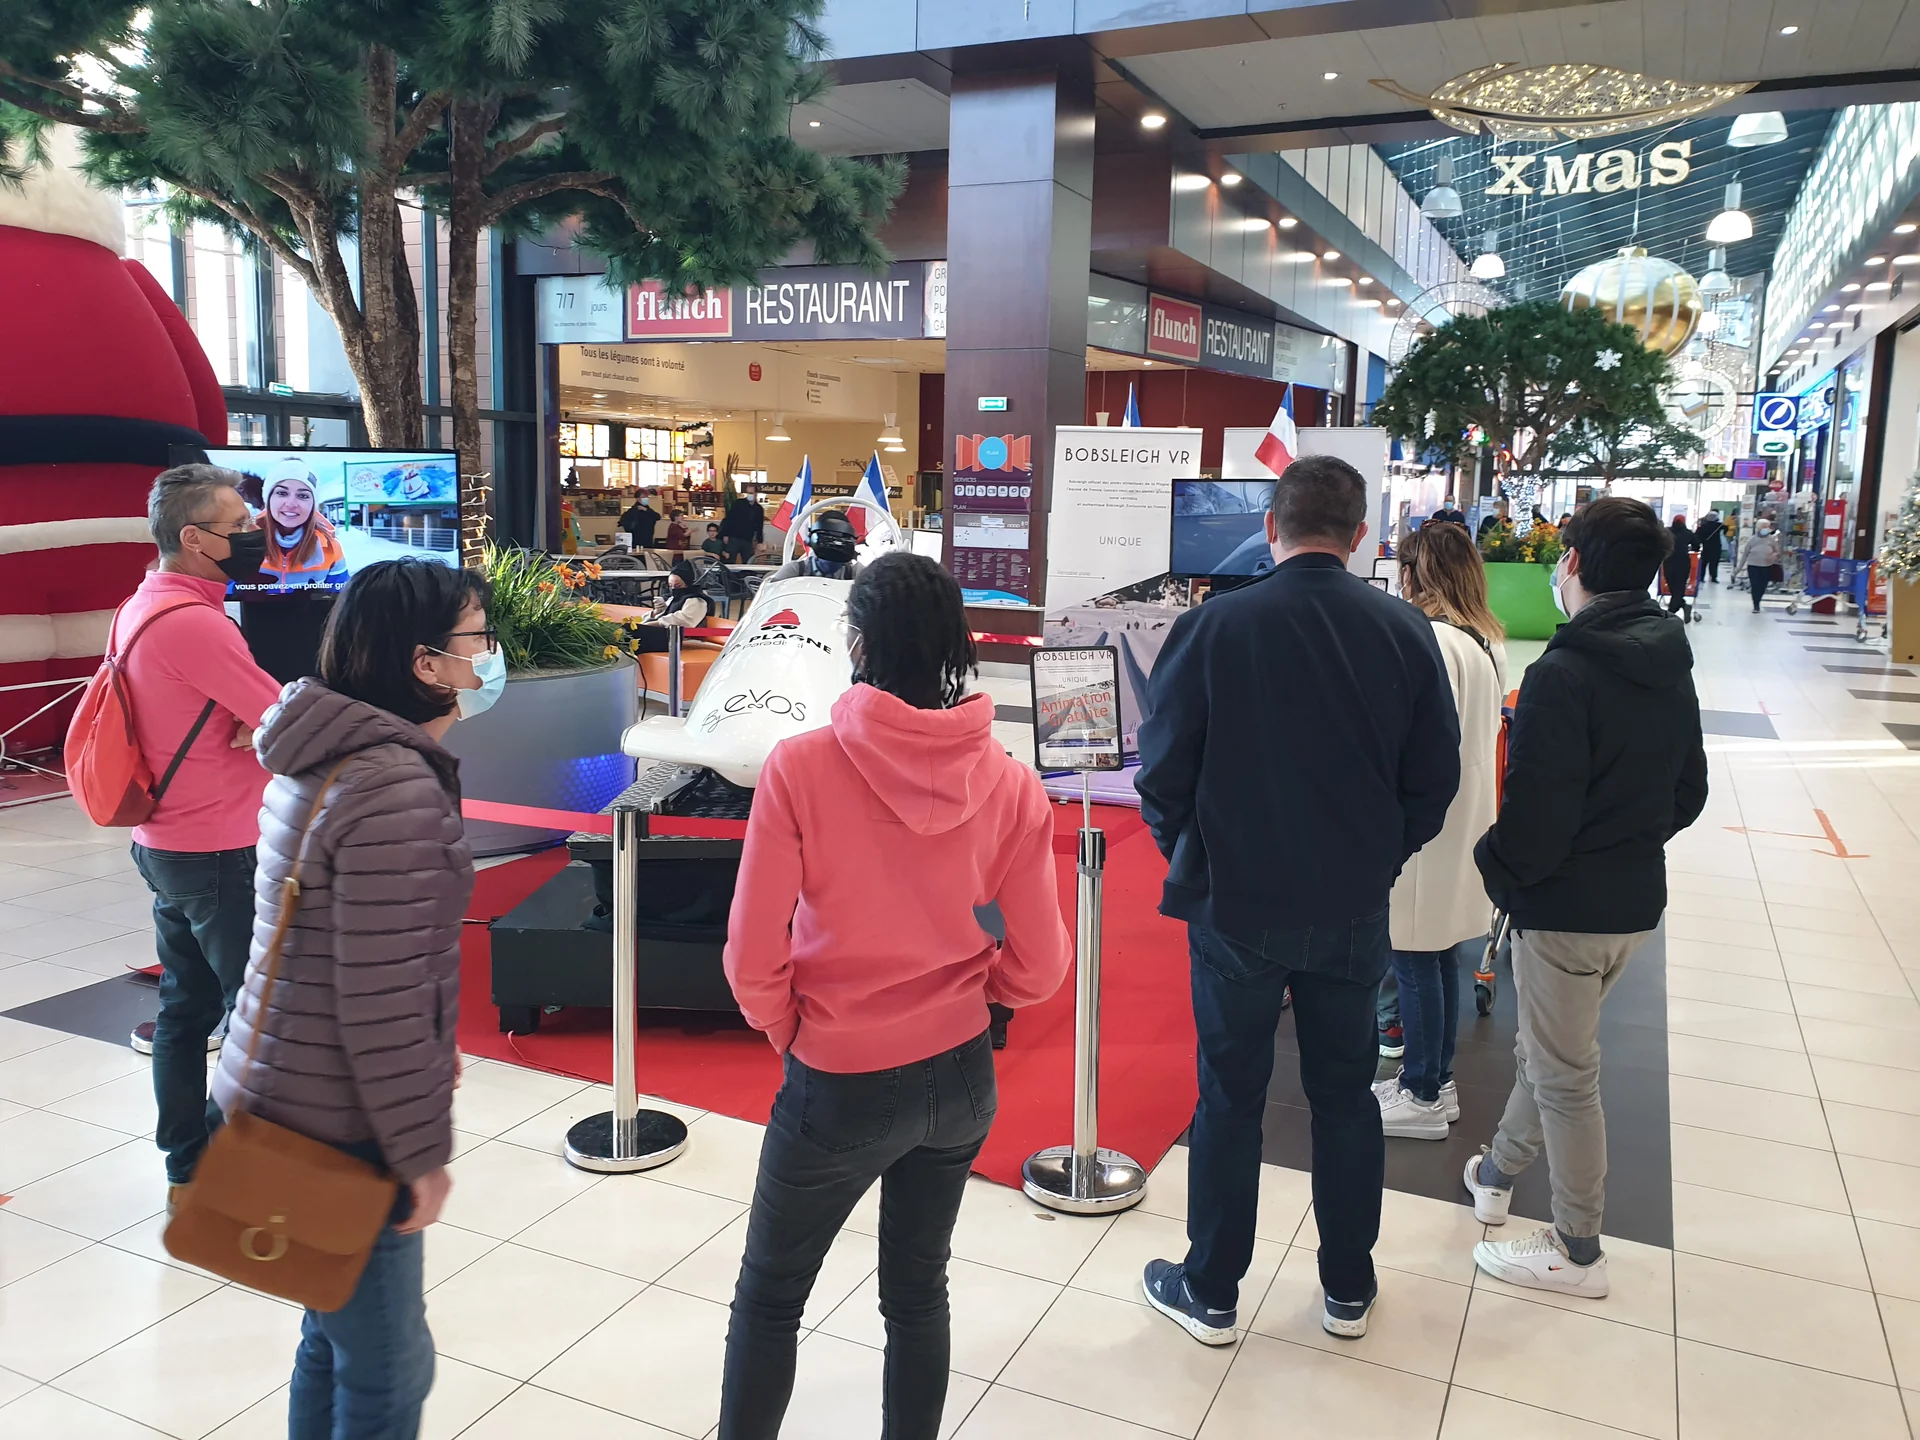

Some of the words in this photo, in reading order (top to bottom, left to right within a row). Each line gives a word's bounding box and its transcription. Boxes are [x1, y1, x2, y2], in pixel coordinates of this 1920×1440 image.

[556, 293, 574, 309] 7/7
[590, 302, 607, 314] jours
[636, 290, 722, 321] flunch
[746, 280, 910, 325] RESTAURANT
[1153, 307, 1197, 345] flunch
[1206, 318, 1270, 365] RESTAURANT
[580, 345, 597, 358] Tous
[598, 348, 609, 360] les
[610, 349, 639, 364] légumes
[640, 356, 655, 366] sont
[656, 357, 660, 368] à
[661, 358, 685, 371] volonté
[1065, 448, 1160, 464] BOBSLEIGH
[1168, 450, 1190, 464] VR
[1099, 536, 1142, 547] UNIQUE
[258, 583, 288, 592] pouvez
[304, 582, 333, 591] profiter
[748, 633, 832, 654] PLAGNE
[1036, 651, 1094, 662] BOBSLEIGH
[1098, 650, 1112, 660] VR
[1041, 691, 1112, 713] Animation
[1049, 706, 1108, 727] Gratuite
